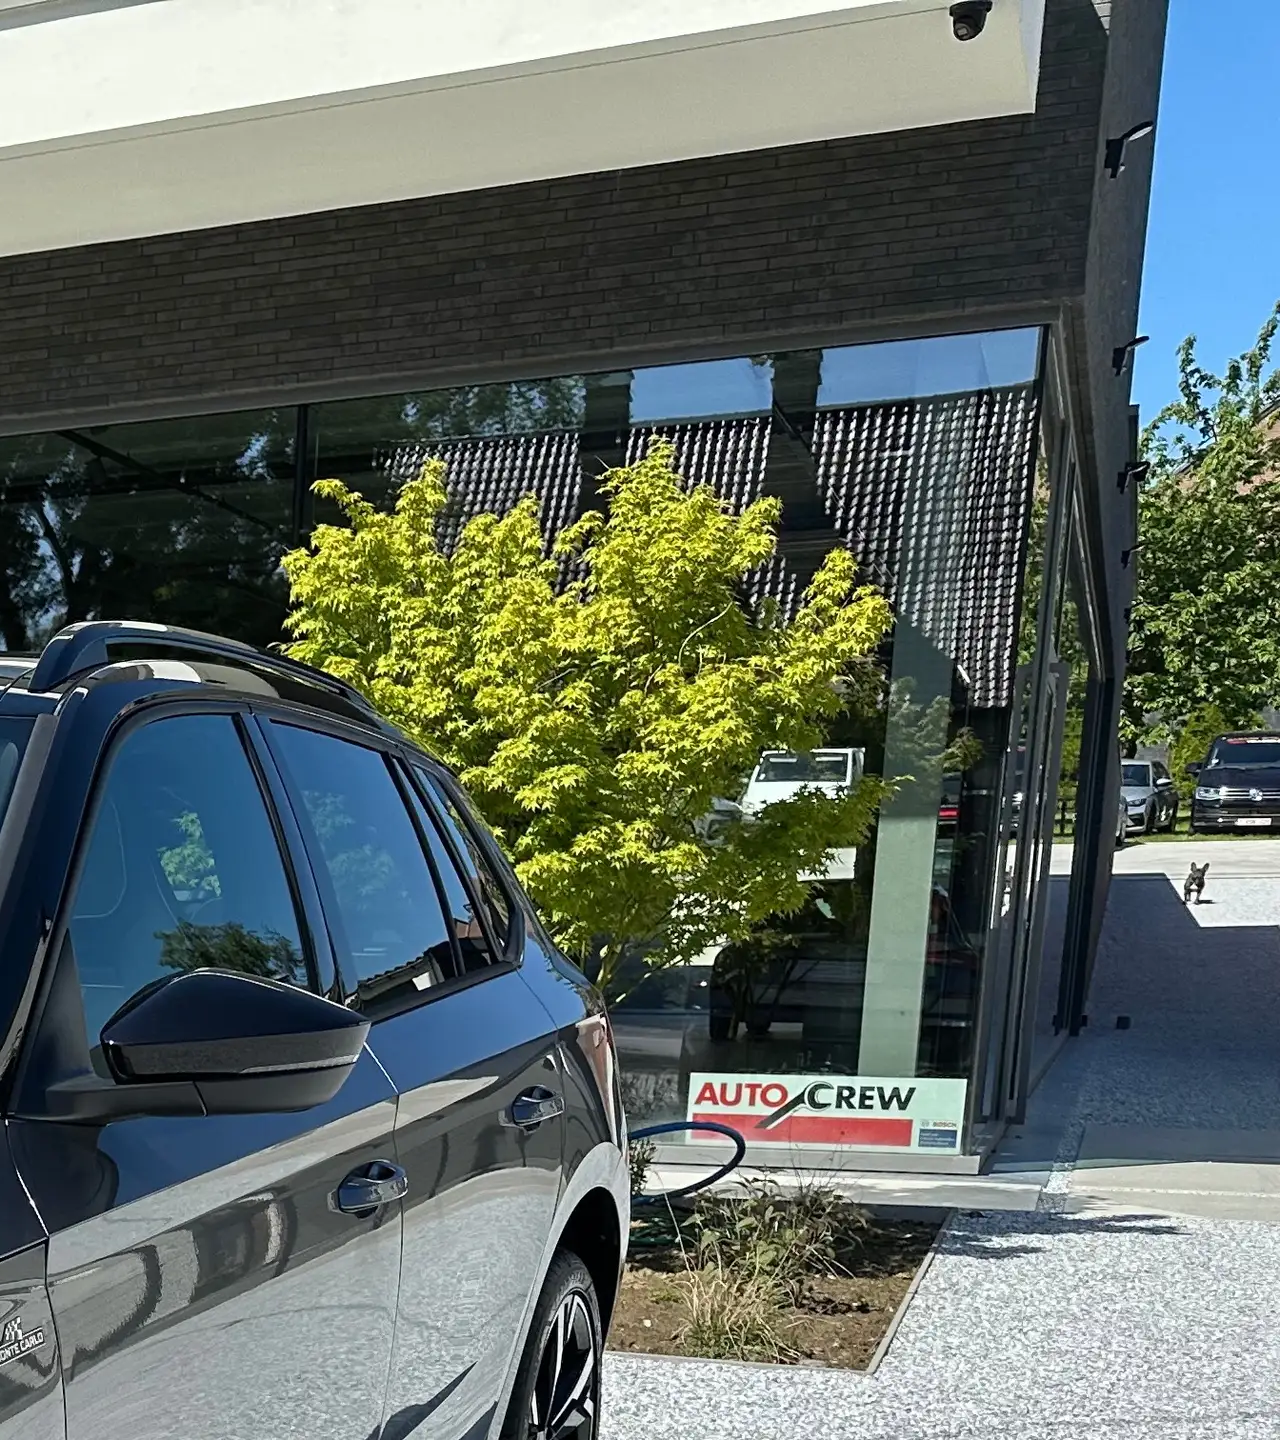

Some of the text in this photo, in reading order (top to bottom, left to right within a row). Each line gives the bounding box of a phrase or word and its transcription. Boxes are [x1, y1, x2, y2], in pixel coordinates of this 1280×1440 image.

[694, 1081, 916, 1111] AUTO CREW
[20, 1332, 44, 1351] CARLO
